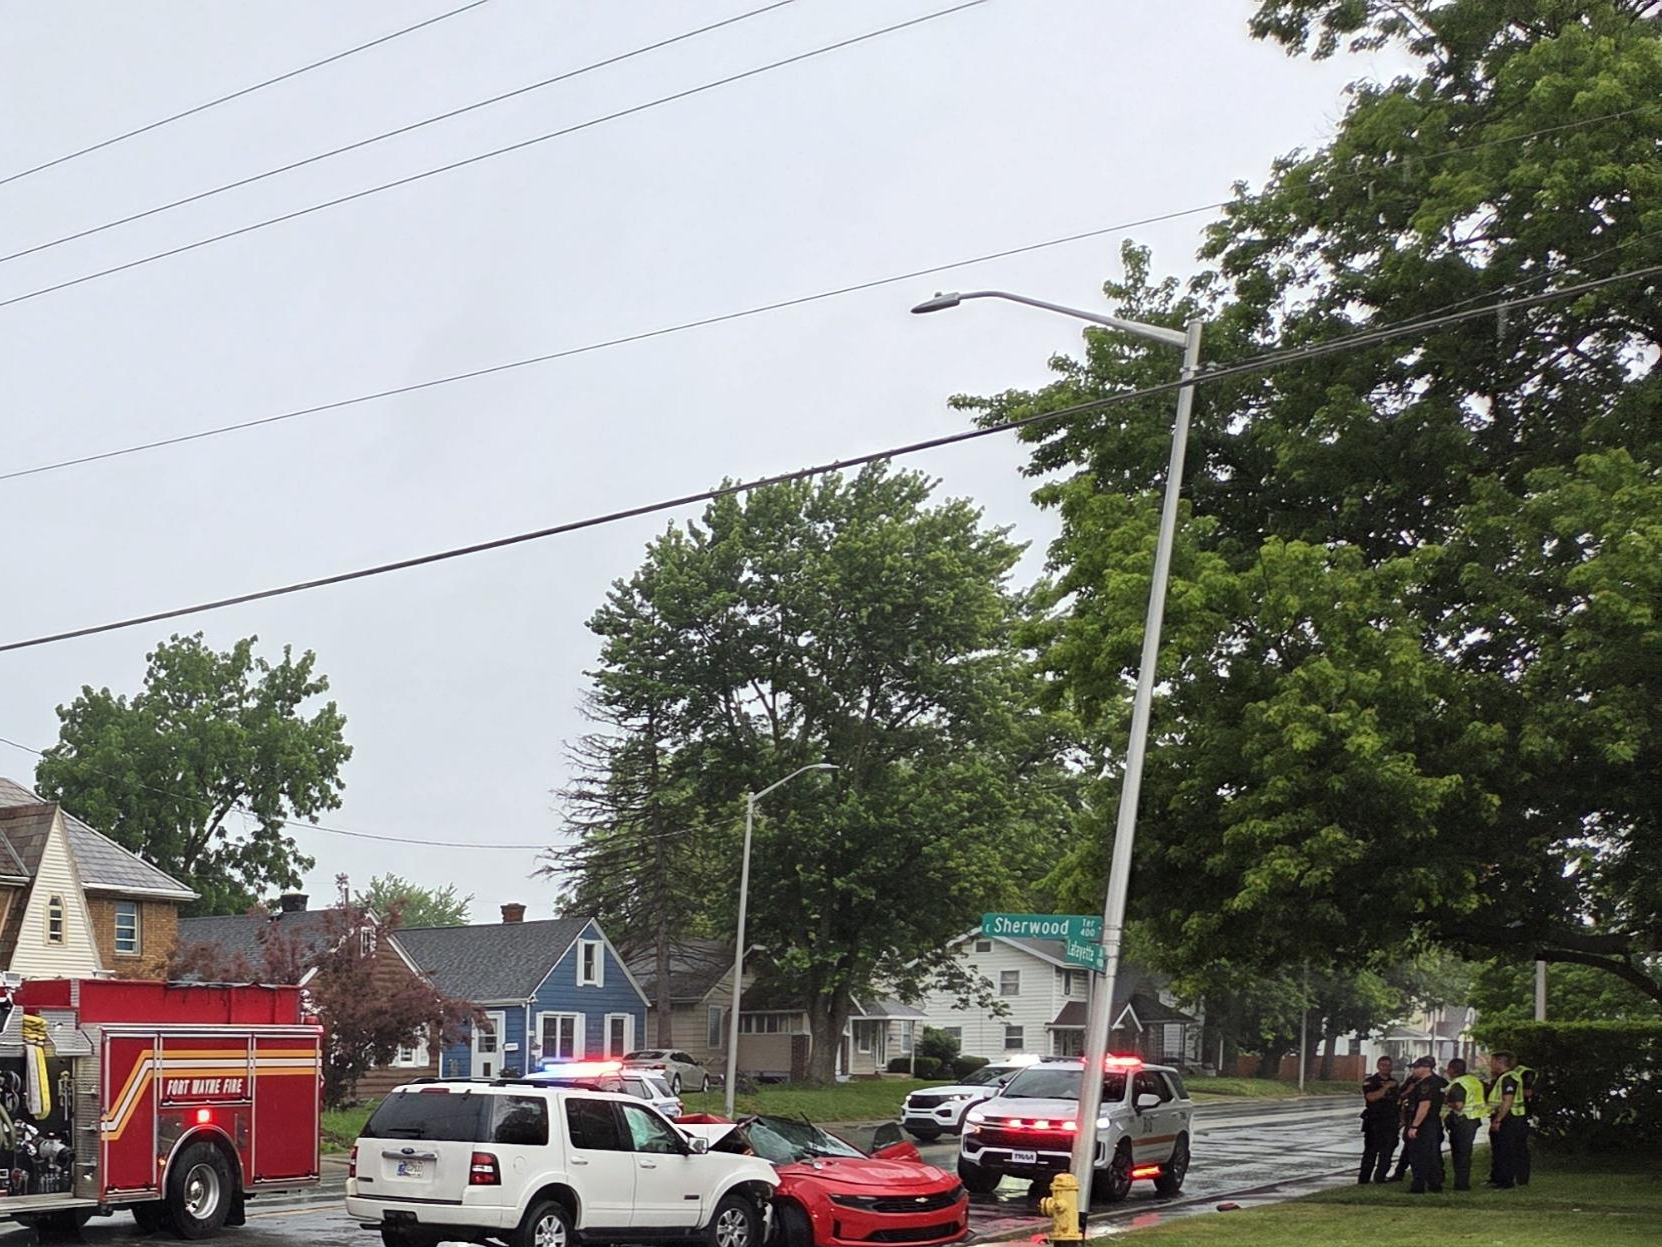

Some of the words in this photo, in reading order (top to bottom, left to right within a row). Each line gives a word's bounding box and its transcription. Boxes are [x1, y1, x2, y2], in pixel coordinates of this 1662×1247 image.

[993, 917, 1069, 935] Sherwood
[1082, 919, 1095, 927] Ter
[1080, 928, 1096, 937] 400
[166, 1080, 190, 1095] FORT
[191, 1079, 221, 1095] WAYNE
[222, 1078, 243, 1094] FIRE
